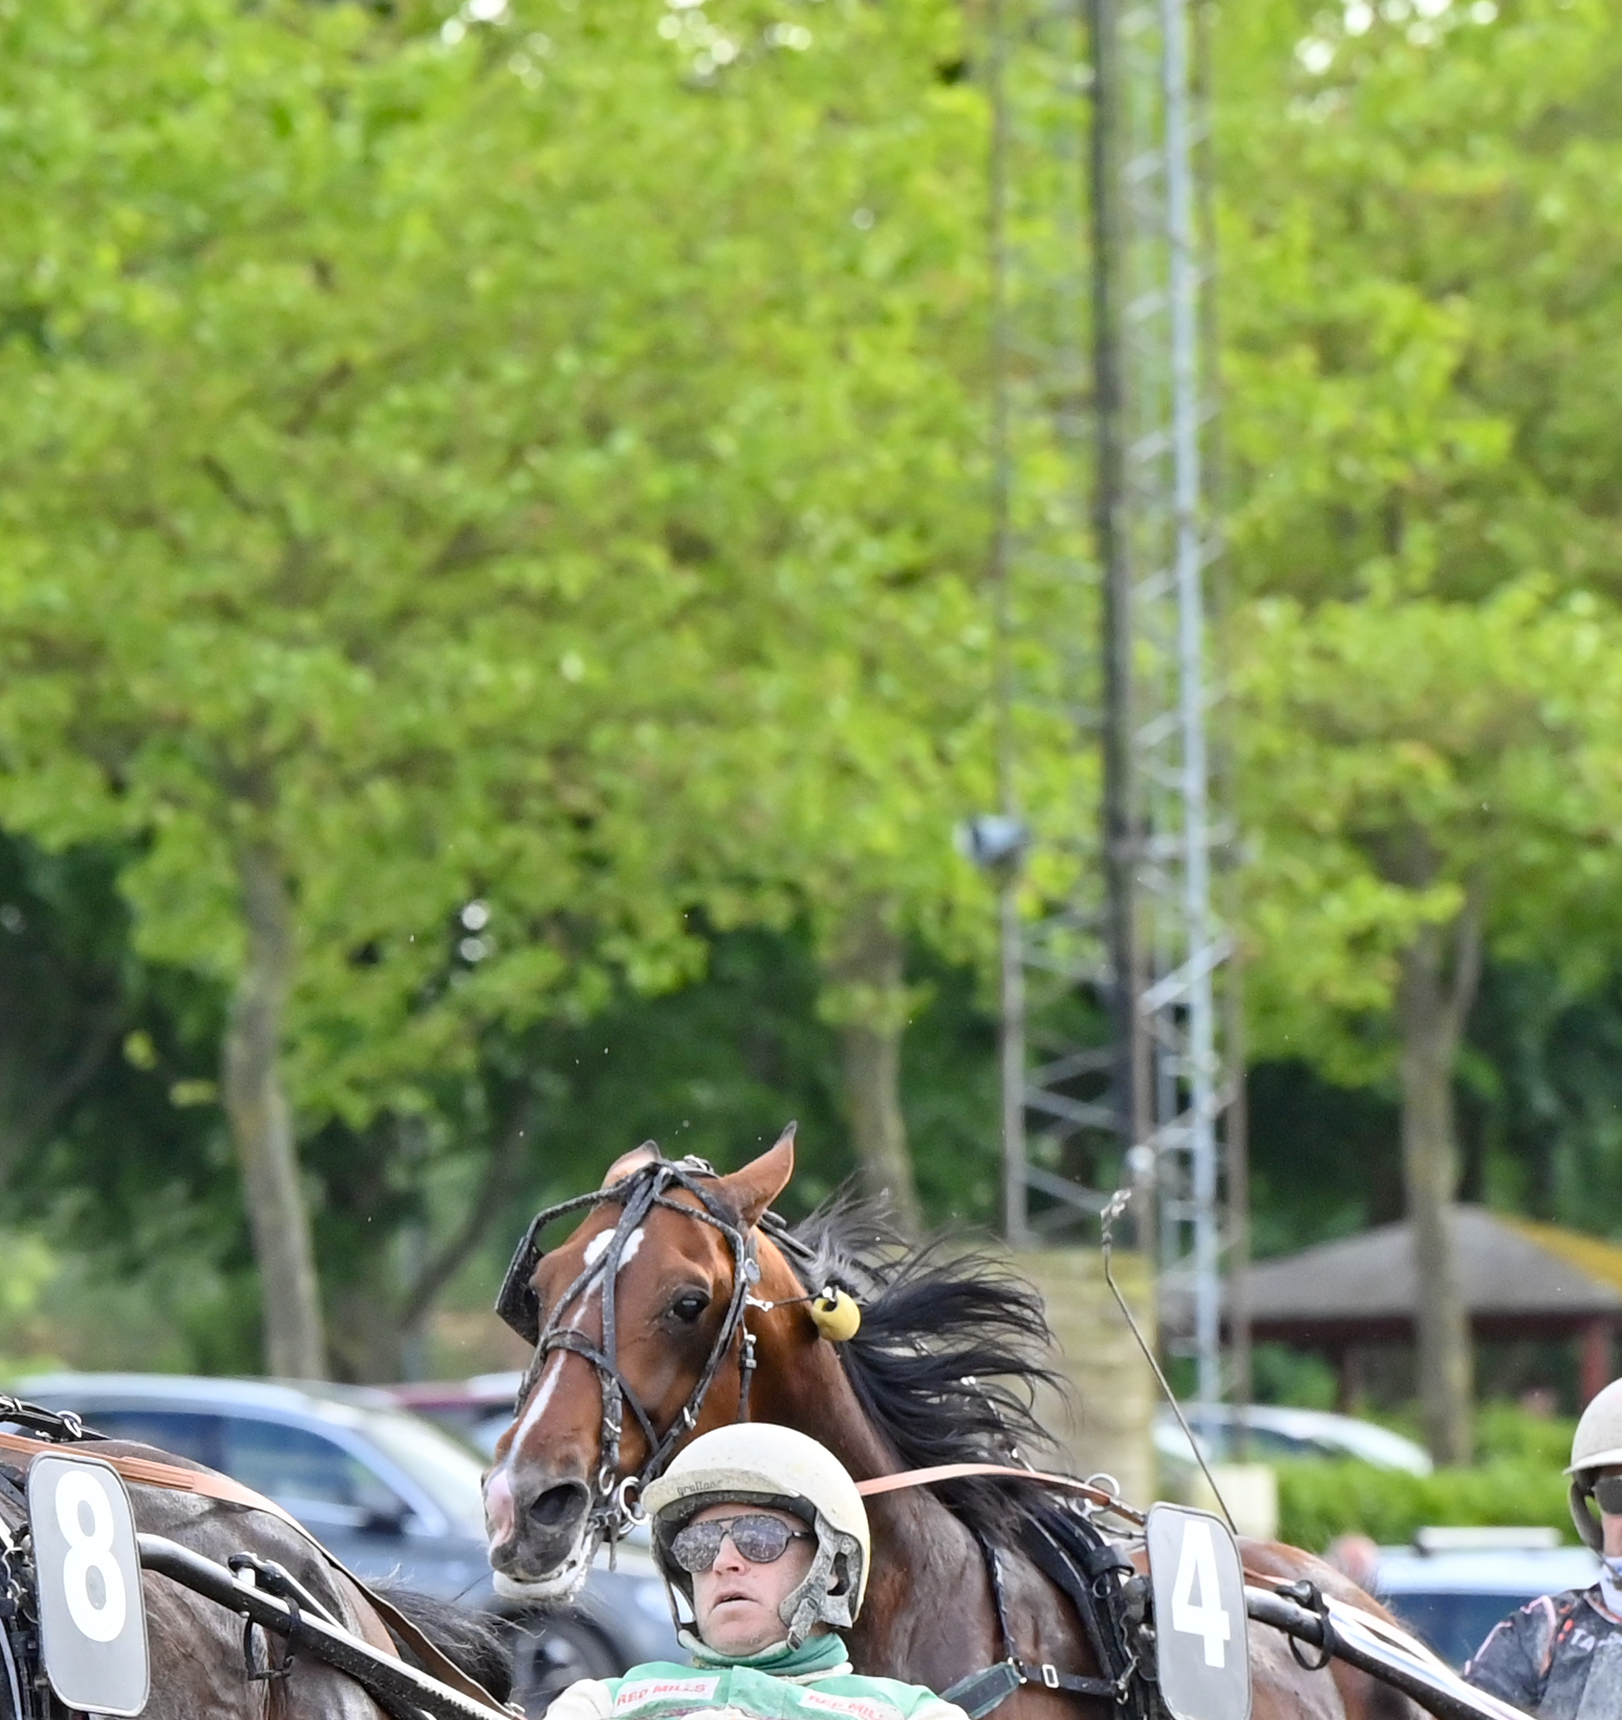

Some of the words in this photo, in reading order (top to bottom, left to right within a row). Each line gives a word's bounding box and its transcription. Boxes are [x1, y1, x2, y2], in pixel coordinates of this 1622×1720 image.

[55, 1470, 126, 1642] 8
[1172, 1520, 1230, 1668] 4
[617, 1688, 649, 1706] RED
[652, 1683, 707, 1694] MILLS
